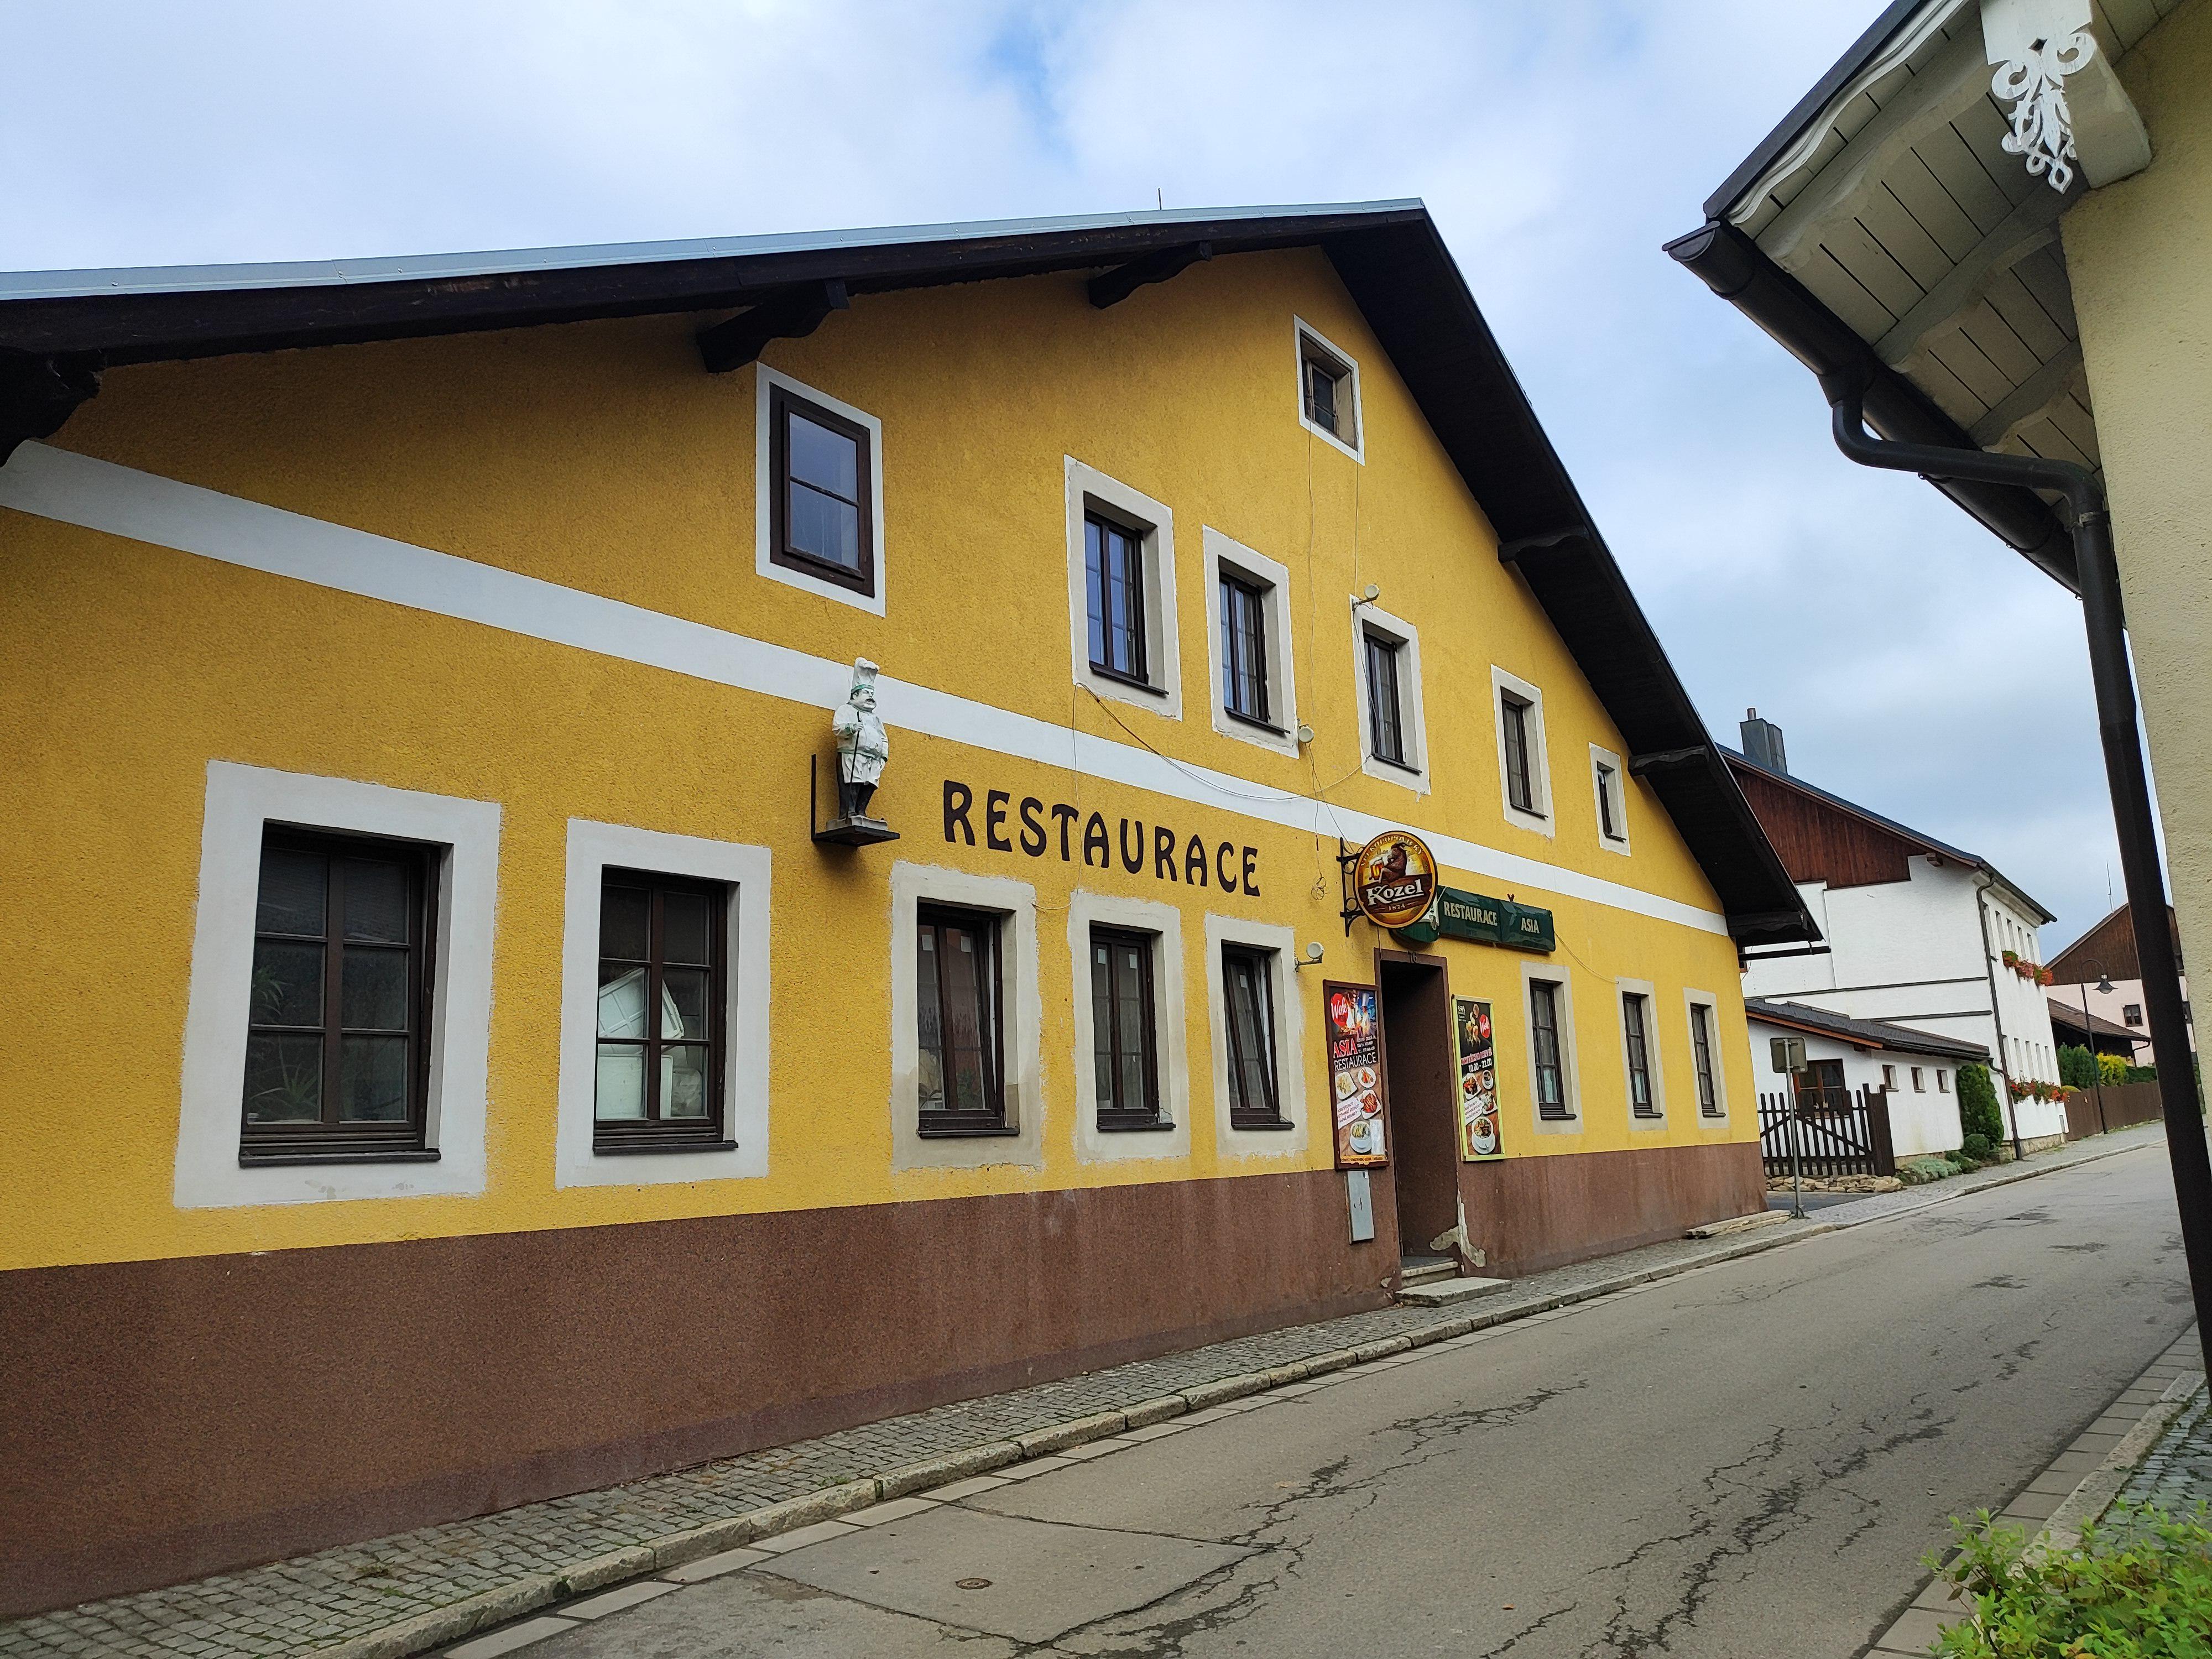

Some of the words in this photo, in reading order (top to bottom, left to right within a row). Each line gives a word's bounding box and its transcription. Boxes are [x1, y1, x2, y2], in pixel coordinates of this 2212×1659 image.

[943, 779, 1261, 897] RESTAURACE
[1366, 879, 1424, 906] Kozel
[1443, 901, 1498, 926] RESTAURACE
[1521, 917, 1540, 934] ASIA
[1331, 997, 1348, 1020] Wok
[1333, 1038, 1358, 1058] ASIA
[1334, 1052, 1377, 1072] RESTAURACE
[1468, 1062, 1479, 1073] 10.00
[1481, 1058, 1492, 1068] 22.00
